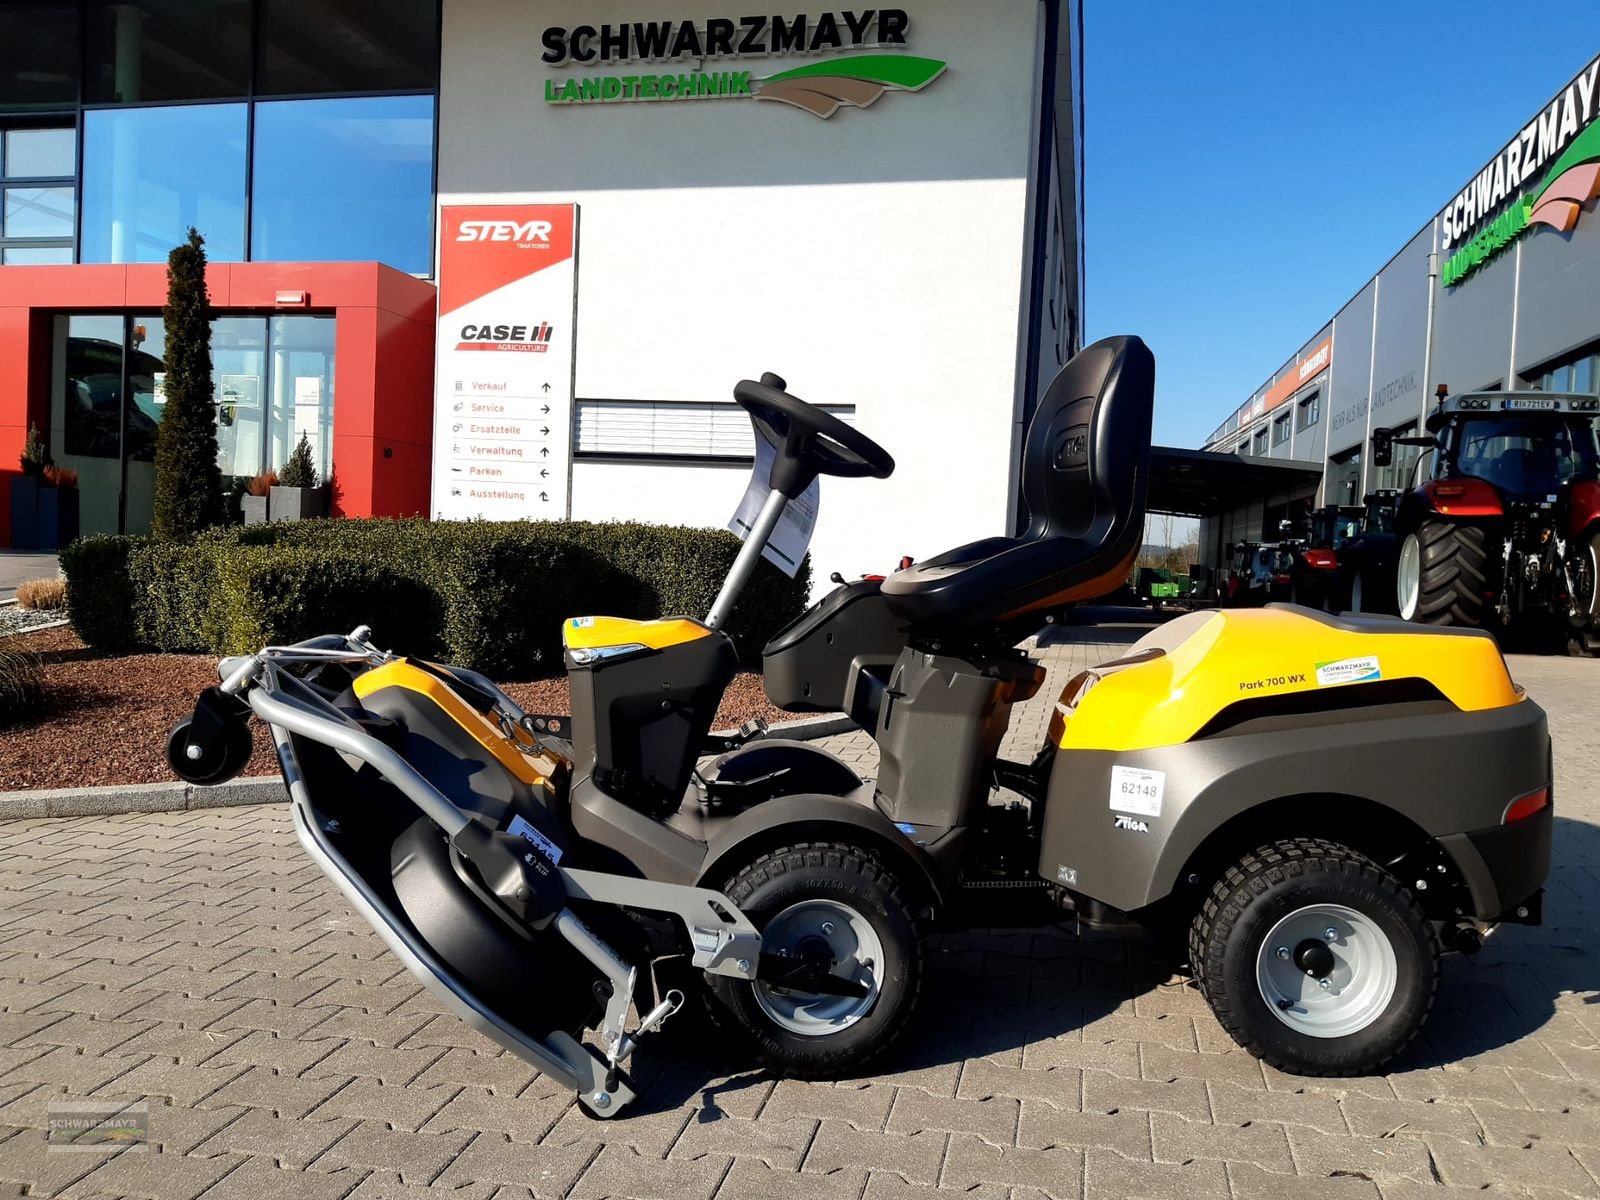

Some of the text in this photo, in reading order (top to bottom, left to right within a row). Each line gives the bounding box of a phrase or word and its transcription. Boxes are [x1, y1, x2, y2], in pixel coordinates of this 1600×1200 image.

[541, 8, 910, 64] SCHWARZMAYR
[544, 71, 752, 103] LANDTECHNIK
[455, 220, 552, 242] STEYR
[460, 324, 527, 341] CASE
[497, 344, 546, 352] AGRICULTURE
[471, 381, 507, 391] Verkauf
[471, 403, 505, 412] Service
[470, 424, 521, 434] Ersatzteile
[470, 446, 523, 457] Verwaltung
[469, 467, 502, 476] Parken
[469, 490, 525, 501] Ausstellung
[1322, 661, 1371, 673] SCHWARZMAYR
[1239, 674, 1306, 690] Park 700 WX
[1121, 782, 1157, 797] 62148
